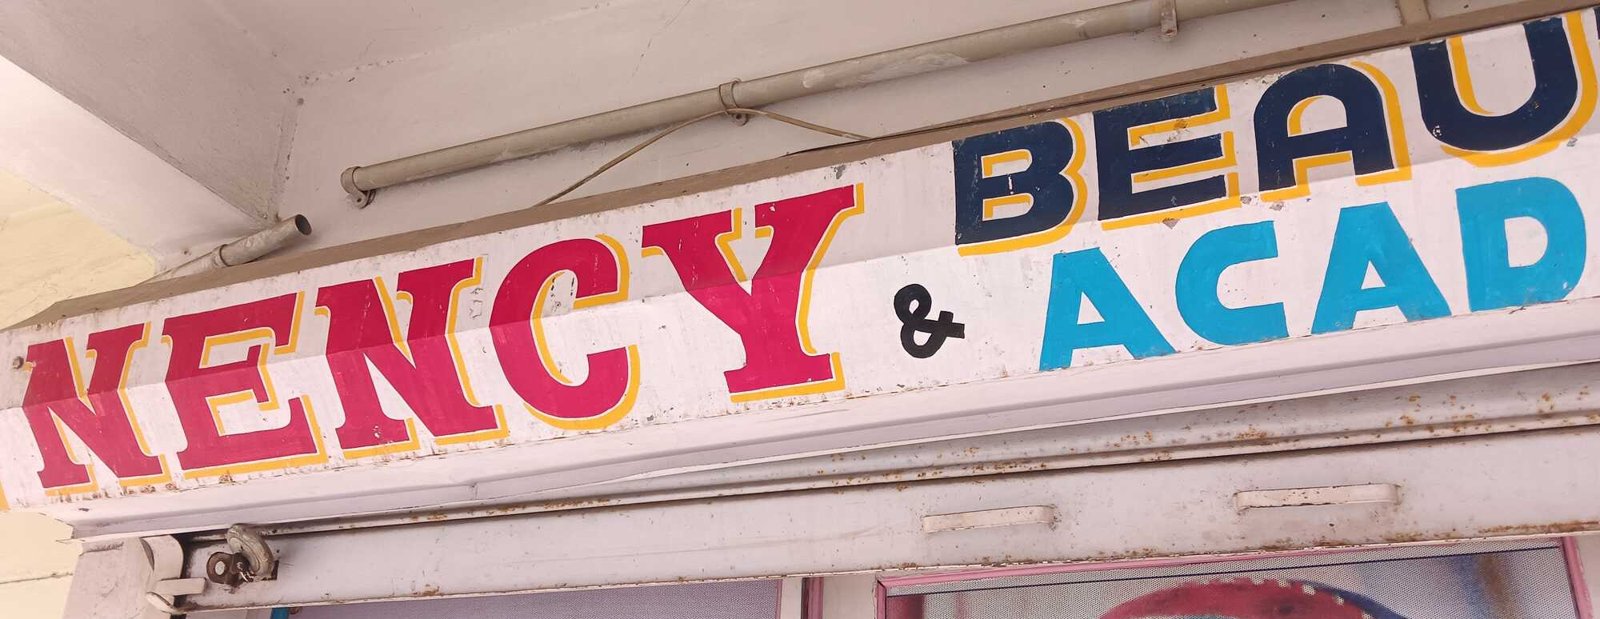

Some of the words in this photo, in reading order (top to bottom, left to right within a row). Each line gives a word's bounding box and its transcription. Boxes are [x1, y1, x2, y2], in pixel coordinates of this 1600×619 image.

[21, 183, 865, 496] NENCY
[952, 6, 1600, 257] BEAU
[893, 283, 966, 359] &
[1038, 176, 1587, 372] ACAD
